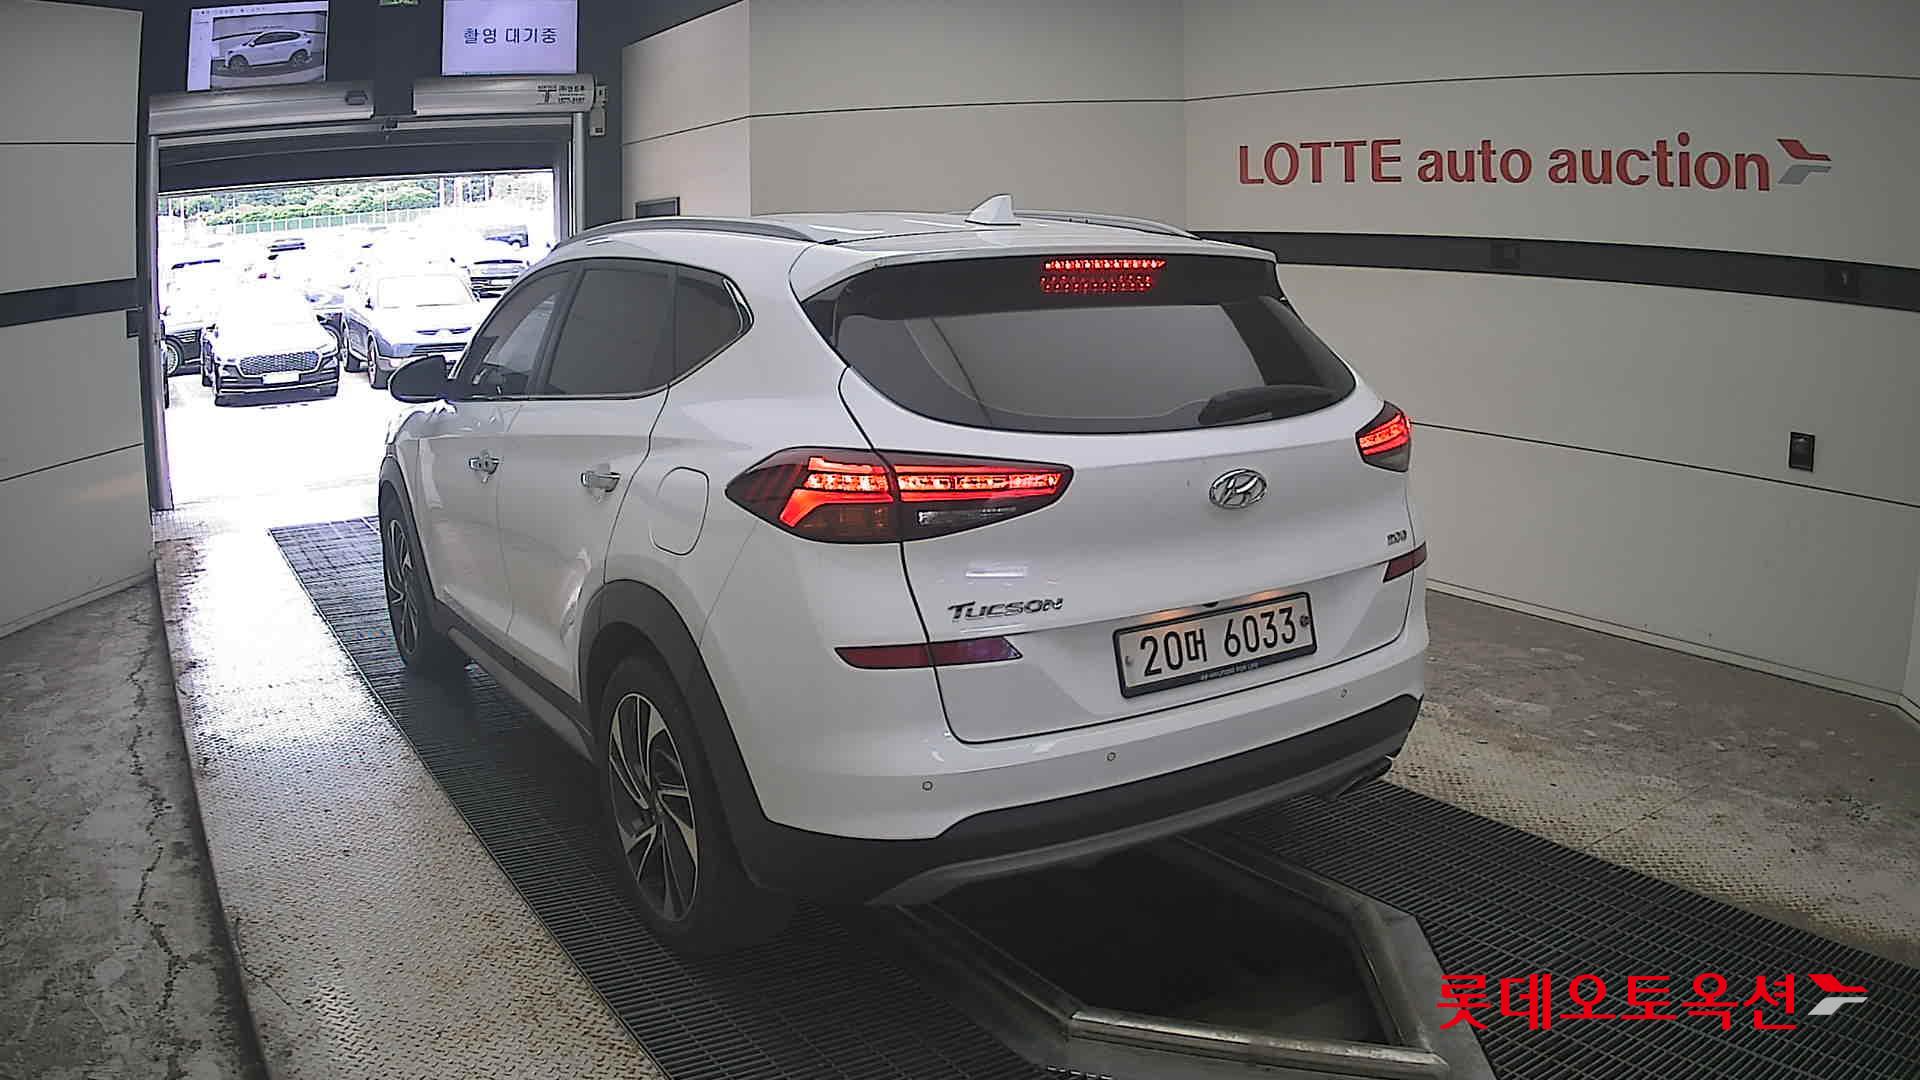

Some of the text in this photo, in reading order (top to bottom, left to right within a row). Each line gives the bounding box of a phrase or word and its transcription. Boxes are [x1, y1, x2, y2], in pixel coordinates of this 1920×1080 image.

[463, 27, 560, 45] 촬영 대기중
[1239, 132, 1771, 192] LOTTE auto auction
[947, 598, 1064, 620] TUCSON
[1139, 605, 1297, 677] 20머 6033
